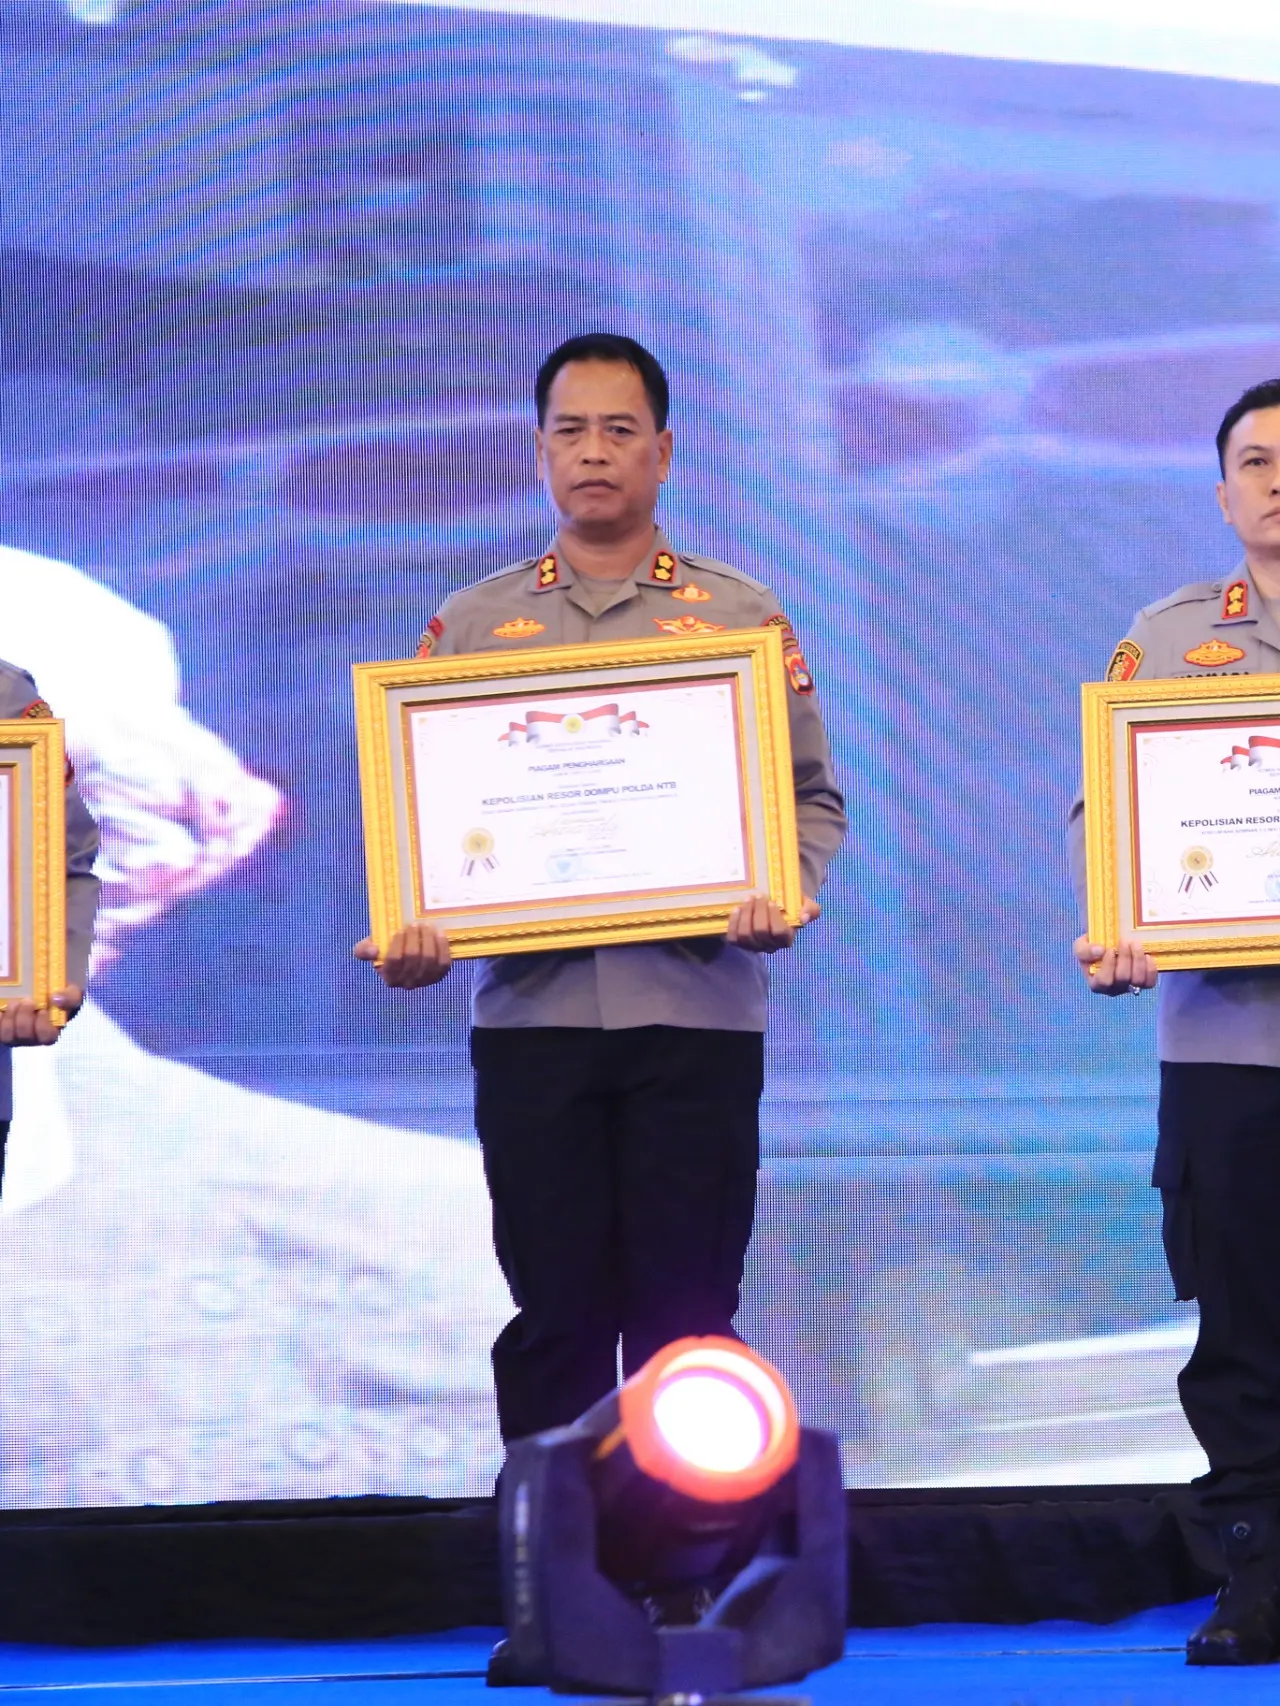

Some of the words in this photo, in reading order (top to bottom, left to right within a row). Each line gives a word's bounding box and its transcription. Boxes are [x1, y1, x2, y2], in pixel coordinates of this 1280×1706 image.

[481, 793, 545, 806] KEPOLISIAN
[547, 789, 582, 800] RESOR
[584, 787, 619, 797] DOMPU
[622, 783, 655, 793] POLDA
[656, 781, 677, 790] NTB
[1180, 817, 1243, 828] KEPOLISIAN
[1245, 815, 1280, 825] RESOR
